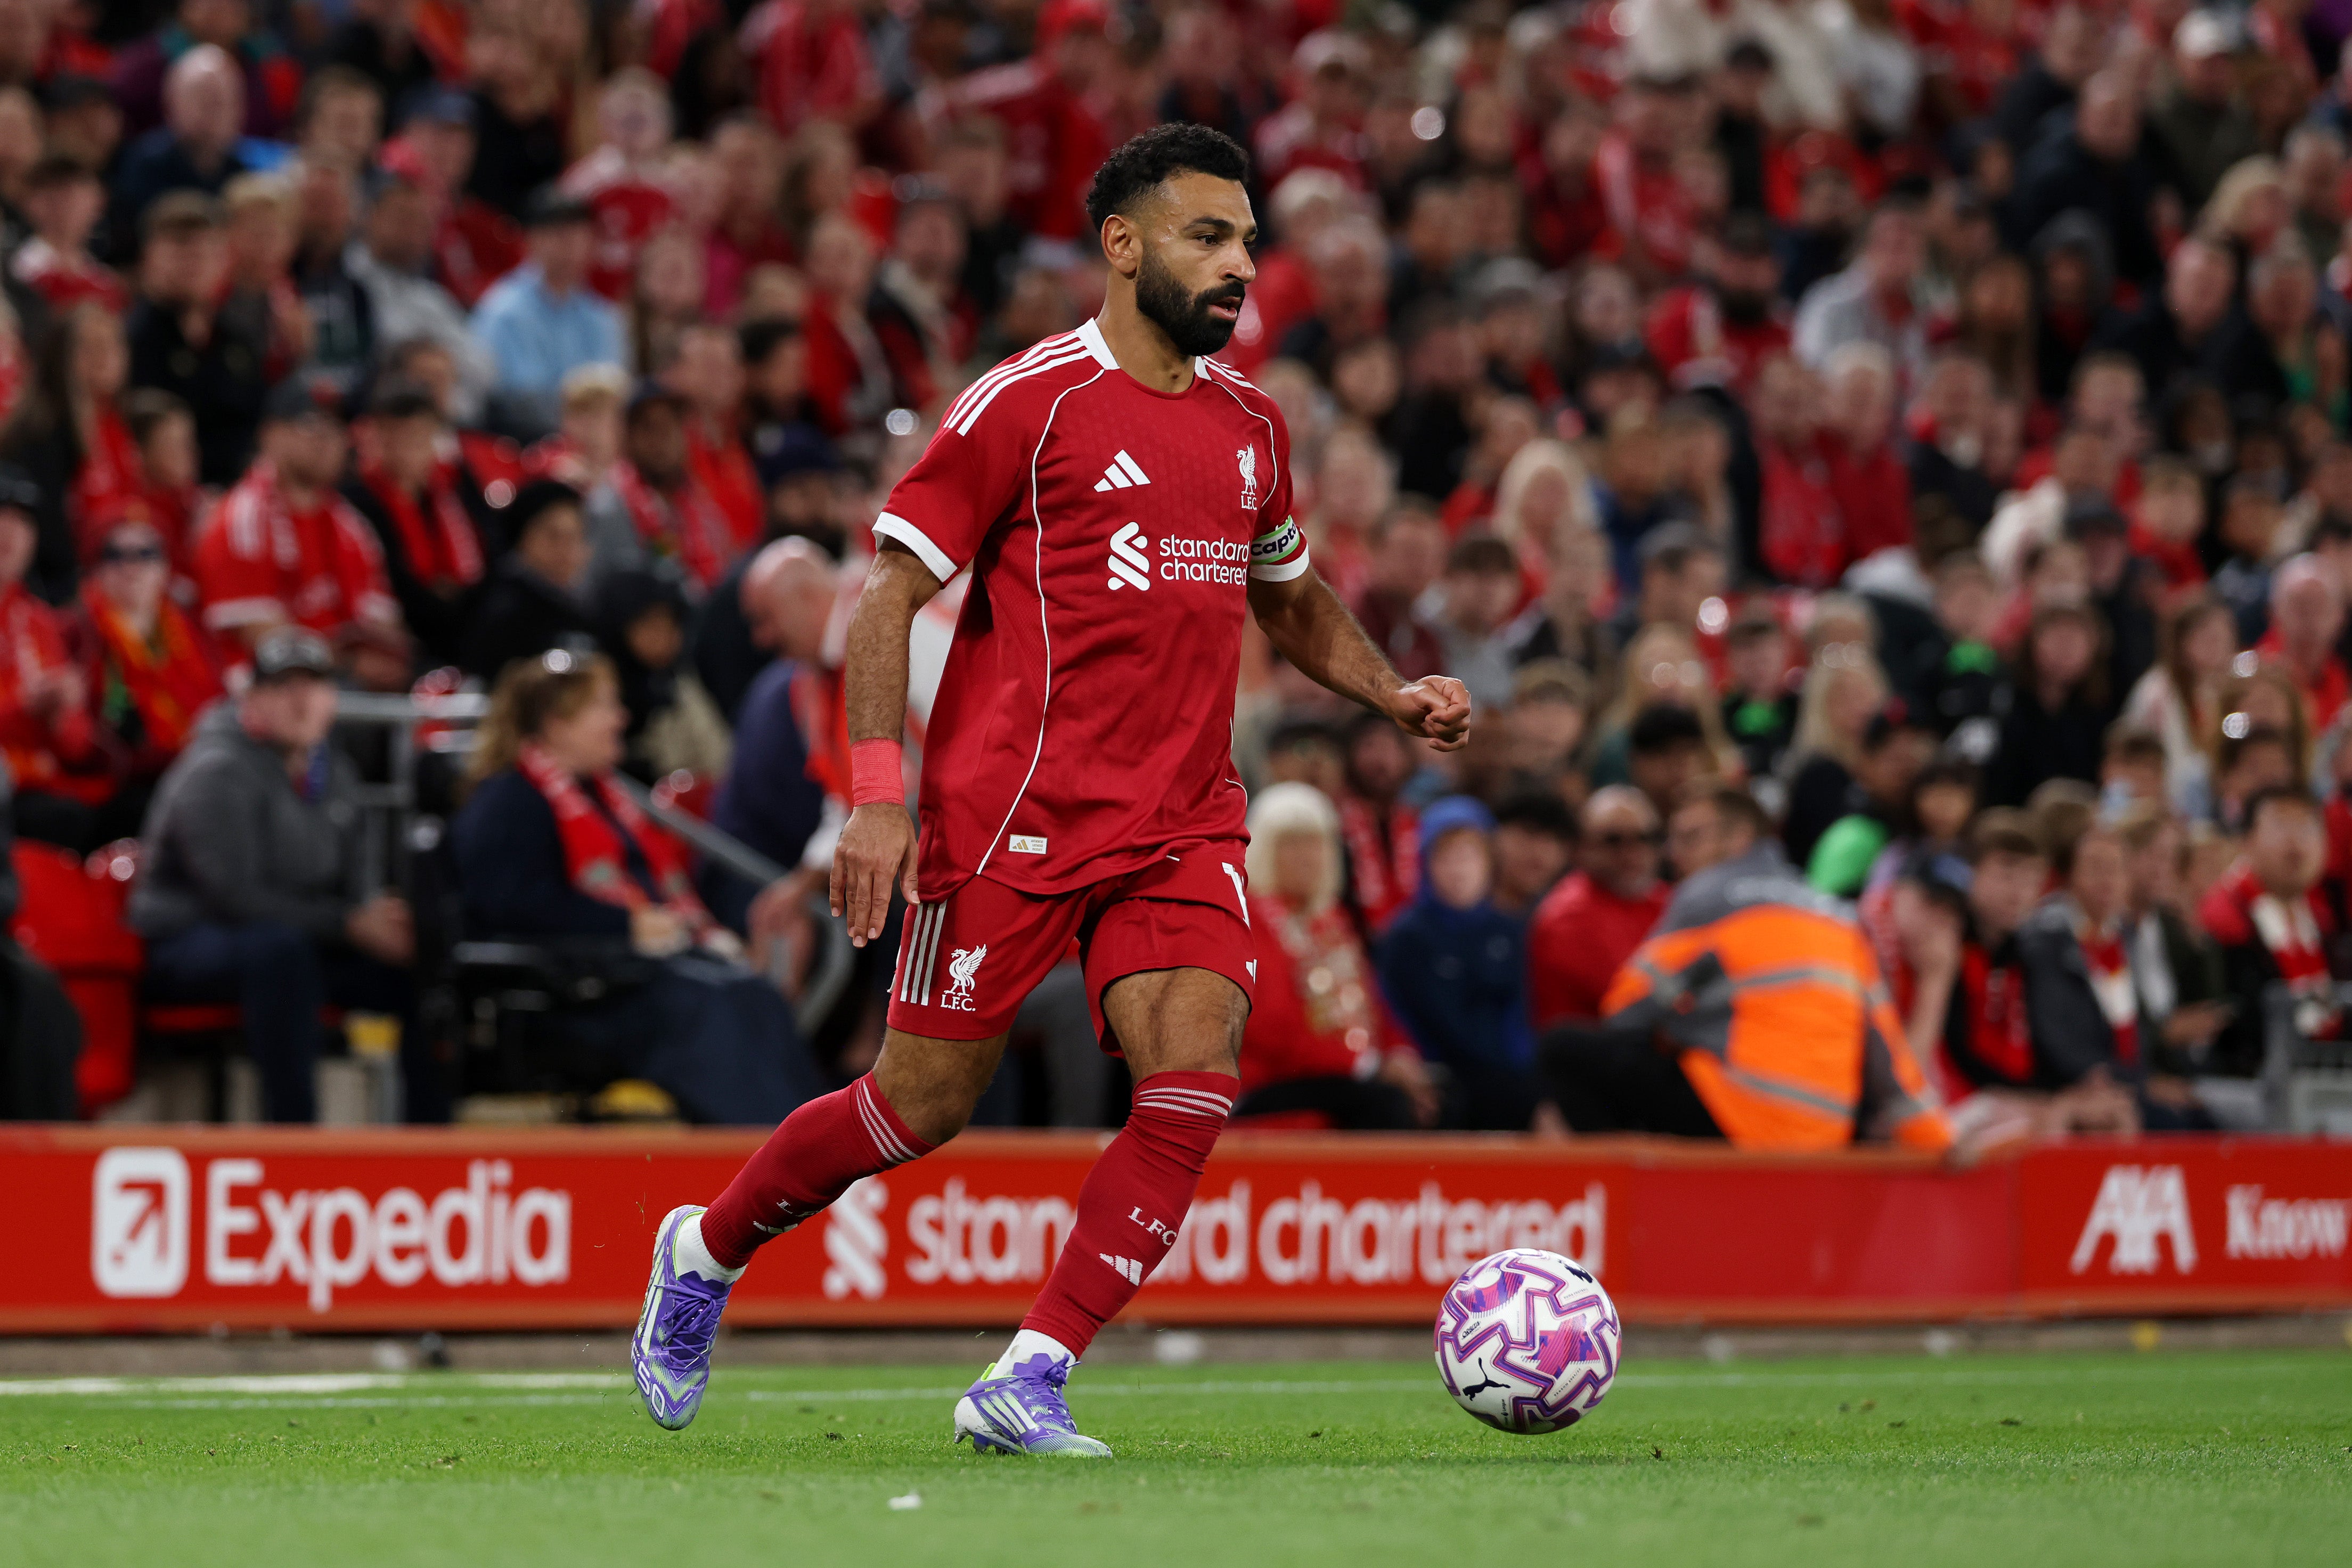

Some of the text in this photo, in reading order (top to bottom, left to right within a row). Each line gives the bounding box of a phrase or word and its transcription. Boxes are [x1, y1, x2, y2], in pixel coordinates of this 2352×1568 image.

[1159, 534, 1250, 562] standard
[1160, 558, 1247, 586] chartered
[941, 994, 976, 1011] L.F.C.
[2070, 1164, 2198, 1275] AXA
[206, 1158, 571, 1312] Expedia
